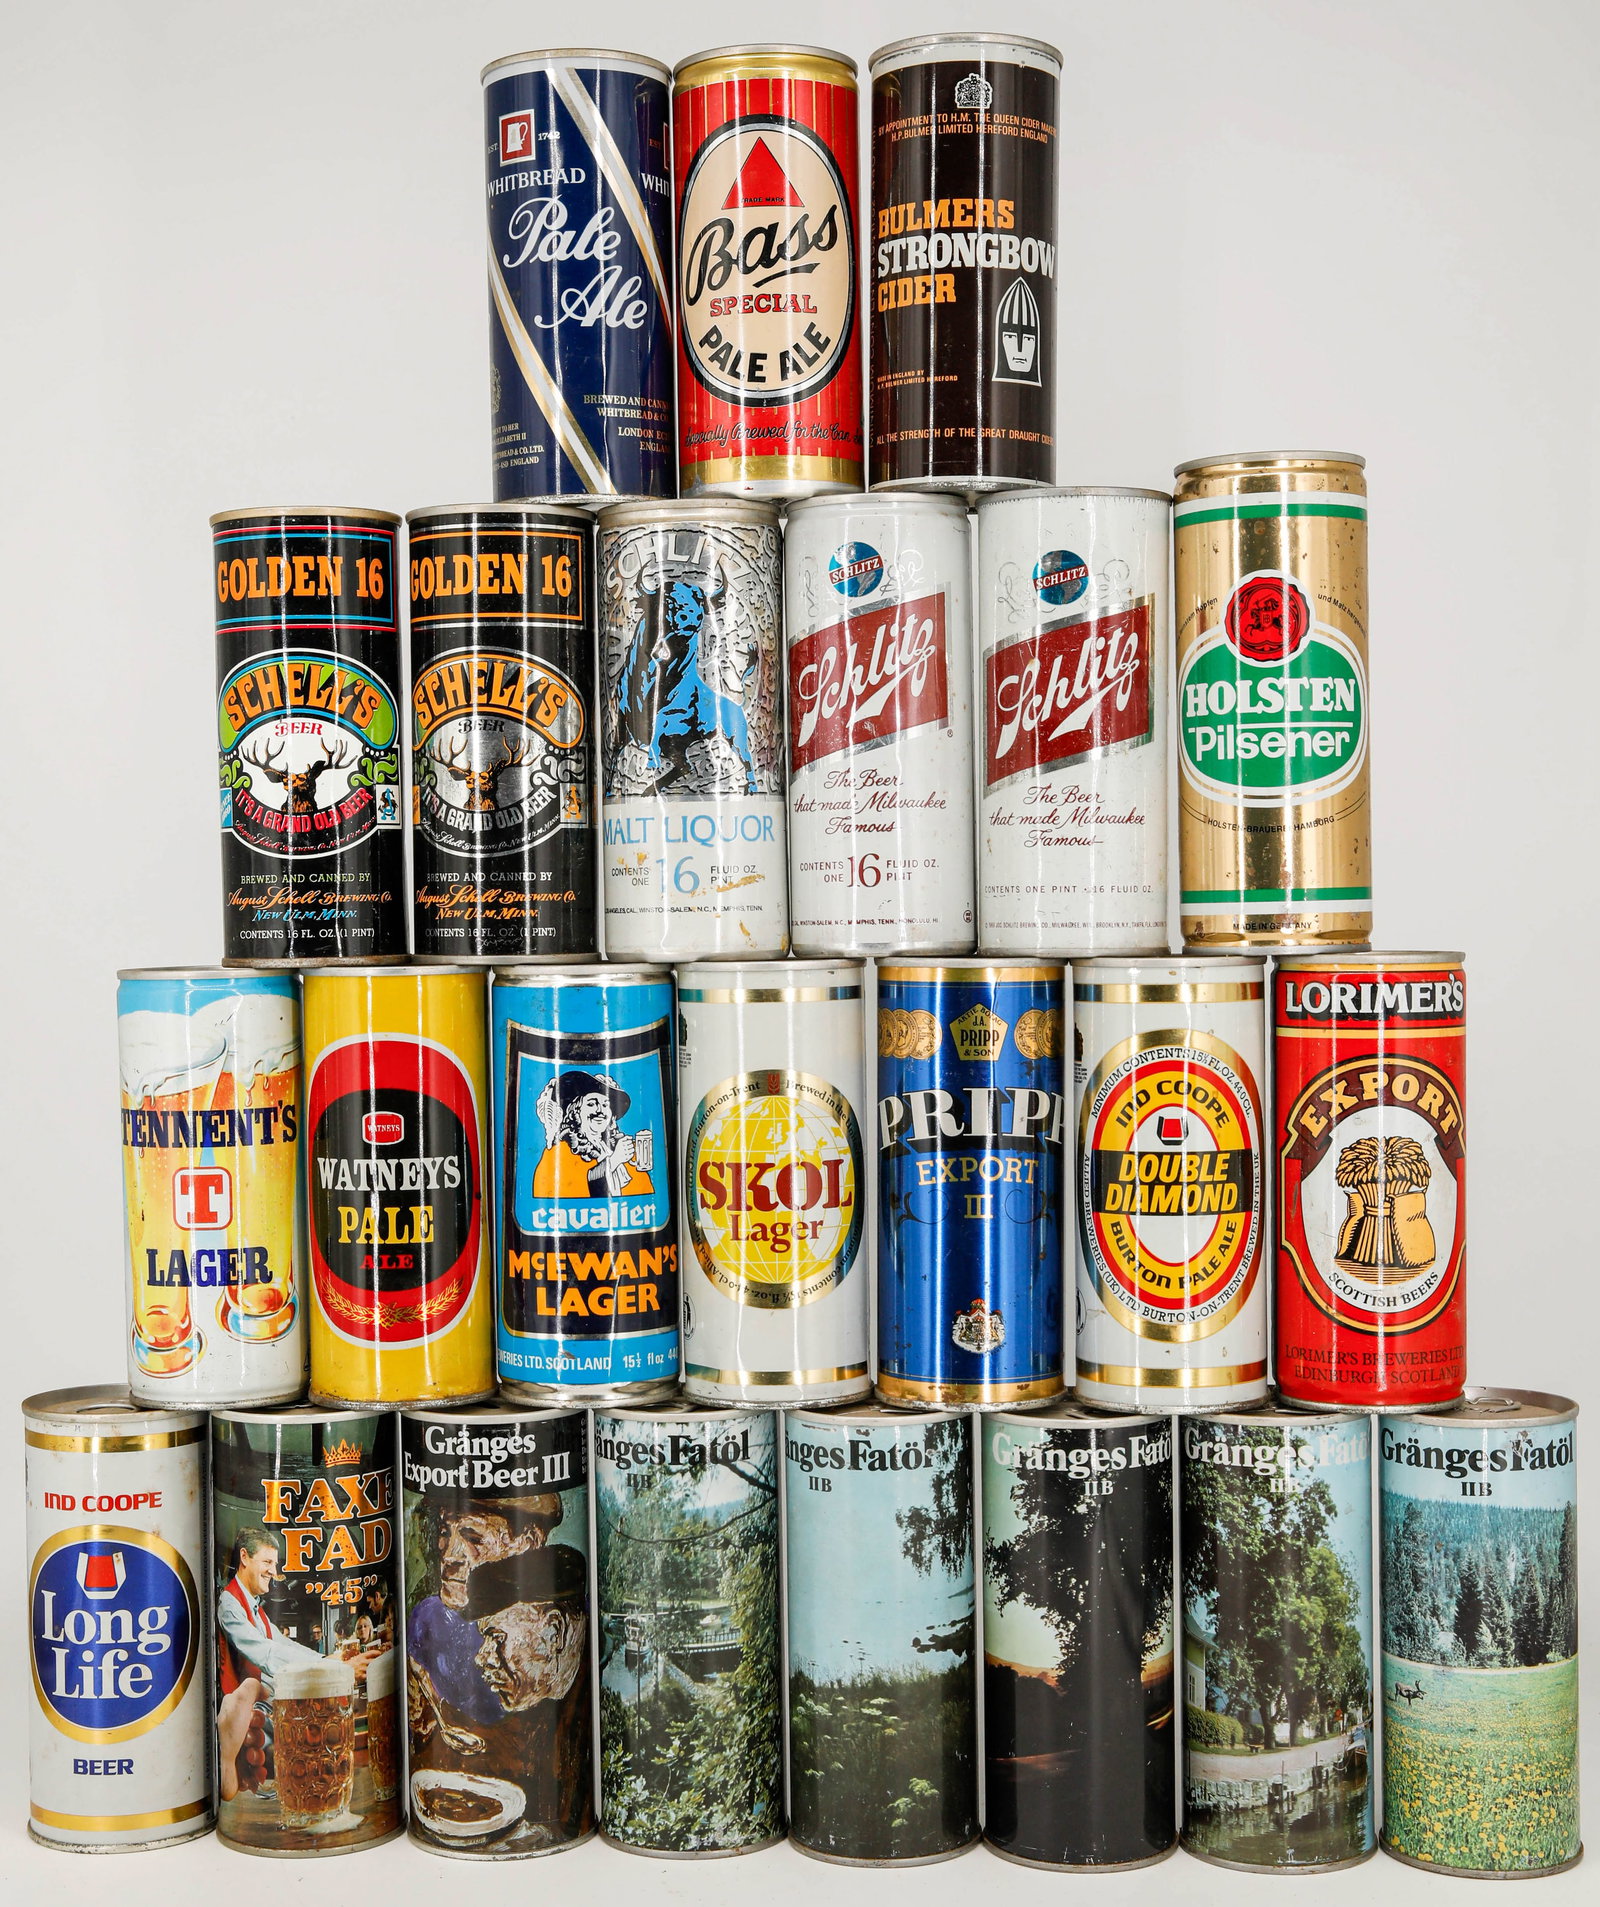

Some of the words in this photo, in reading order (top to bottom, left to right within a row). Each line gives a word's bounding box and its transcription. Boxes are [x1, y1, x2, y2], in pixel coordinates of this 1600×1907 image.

[885, 115, 934, 133] APPOINTMENT
[937, 114, 947, 123] TO
[951, 113, 971, 122] H.M.
[974, 113, 991, 123] THE
[994, 114, 1019, 125] QUEEN
[1022, 117, 1040, 128] CIDER
[488, 168, 586, 198] WHITBREAD
[503, 194, 621, 268] Pale
[878, 198, 1014, 239] BULMERS
[686, 204, 838, 306] Bass
[878, 232, 1056, 279] STRONGBOW
[534, 265, 647, 329] Ale
[710, 294, 817, 317] SPECIAL
[878, 273, 956, 313] CIDER
[699, 325, 767, 382] PALE
[779, 322, 830, 381] ALE
[584, 395, 626, 405] BREWED
[628, 396, 646, 406] AND
[618, 426, 653, 438] LONDON
[731, 421, 788, 443] Brewed
[788, 421, 811, 443] for
[811, 424, 829, 440] the
[830, 424, 850, 441] Can
[877, 434, 885, 445] ALL
[886, 432, 898, 442] THE
[900, 429, 941, 441] STRENGTH
[944, 428, 955, 437] OF
[960, 428, 976, 437] THE
[981, 428, 1006, 439] GREAT
[1009, 430, 1040, 443] DRAUGHT
[510, 456, 539, 466] ENGLAND
[217, 556, 343, 603] GOLDEN
[356, 557, 384, 599] 16
[411, 554, 528, 601] GOLDEN
[542, 555, 572, 597] 16
[831, 558, 880, 584] SCHLITZ
[1036, 566, 1086, 591] SCHLITZ
[223, 663, 382, 731] SCHELL'S
[413, 661, 568, 729] SCHELL'S
[798, 614, 936, 747] Schlitz
[995, 627, 1140, 760] Schlitz
[1186, 677, 1355, 717] HOLSTEN
[275, 722, 323, 736] BEER
[458, 719, 505, 734] BEER
[1188, 724, 1350, 761] Pilsener
[824, 768, 857, 789] The
[856, 768, 903, 790] Beer
[1023, 783, 1058, 804] The
[1057, 784, 1105, 806] Beer
[603, 817, 655, 846] MALT
[665, 815, 775, 847] LIQUOR
[825, 816, 903, 834] Famous
[989, 807, 1015, 826] that
[1015, 808, 1061, 825] made
[1056, 806, 1146, 829] Milwaukee
[1294, 816, 1335, 830] HAMBURG
[241, 874, 278, 884] BREWED
[282, 874, 305, 883] AND
[309, 873, 355, 882] CANNED
[359, 873, 370, 881] BY
[427, 872, 460, 882] BREWED
[463, 872, 486, 881] AND
[490, 872, 536, 881] CANNED
[540, 872, 552, 881] BY
[800, 861, 843, 871] CONTENTS
[847, 853, 882, 888] 16
[923, 859, 939, 868] OZ.
[227, 888, 268, 911] August
[252, 886, 321, 910] Schell
[319, 891, 380, 905] BREWING
[1111, 885, 1138, 893] FLUID
[1142, 885, 1154, 893] OZ.
[240, 930, 283, 939] CONTENTS
[287, 929, 298, 938] 16
[302, 929, 316, 938] FL.
[319, 929, 336, 938] OZ.
[352, 928, 374, 937] PINT)
[1285, 973, 1464, 1017] LORIMER'S
[961, 1030, 999, 1046] PRIPP
[1091, 1069, 1124, 1119] MINIMUM
[1123, 1048, 1190, 1073] CONTENTS
[1115, 1089, 1150, 1128] IND
[1157, 1080, 1229, 1128] COOPE
[1300, 1071, 1458, 1138] EXPORT
[122, 1100, 297, 1148] TENNENT'S
[368, 1124, 400, 1132] WATNEYS
[317, 1155, 461, 1191] WATNEYS
[699, 1159, 852, 1213] SKOL
[916, 1156, 1038, 1185] EXPORT
[1119, 1153, 1231, 1183] DOUBLE
[180, 1174, 223, 1224] T
[532, 1202, 656, 1229] cavalier
[964, 1195, 993, 1219] III
[1105, 1182, 1238, 1215] DIAMOND
[337, 1206, 434, 1244] PALE
[731, 1214, 824, 1253] Lager
[1242, 1216, 1258, 1269] BREWED
[146, 1247, 273, 1287] LAGER
[360, 1255, 414, 1269] ALE
[1110, 1220, 1171, 1289] BURTON
[1179, 1255, 1222, 1290] PALE
[1219, 1220, 1238, 1259] ALE
[537, 1283, 660, 1316] LAGER
[1329, 1272, 1397, 1307] SCOTTISH
[1403, 1271, 1439, 1305] BEERS
[525, 1355, 544, 1369] LTD.
[546, 1356, 612, 1370] SCOTLAND
[655, 1354, 664, 1364] oz
[1295, 1365, 1385, 1383] EDINBURGH
[1390, 1365, 1460, 1383] SCOTLAND
[425, 1425, 536, 1463] Gränges
[595, 1429, 665, 1469] änges
[668, 1426, 751, 1466] Fatöl
[992, 1433, 1127, 1479] Gränges
[1184, 1426, 1314, 1476] Gränges
[1381, 1428, 1508, 1479] Gränges
[1510, 1431, 1573, 1471] Fatöl
[404, 1451, 471, 1493] Export
[472, 1460, 539, 1489] Beer
[541, 1451, 570, 1485] III
[44, 1492, 76, 1511] IND
[82, 1492, 162, 1512] COOPE
[281, 1518, 393, 1572] FAD
[41, 1590, 171, 1656] Long
[52, 1647, 153, 1699] Life
[74, 1758, 134, 1775] BEER
